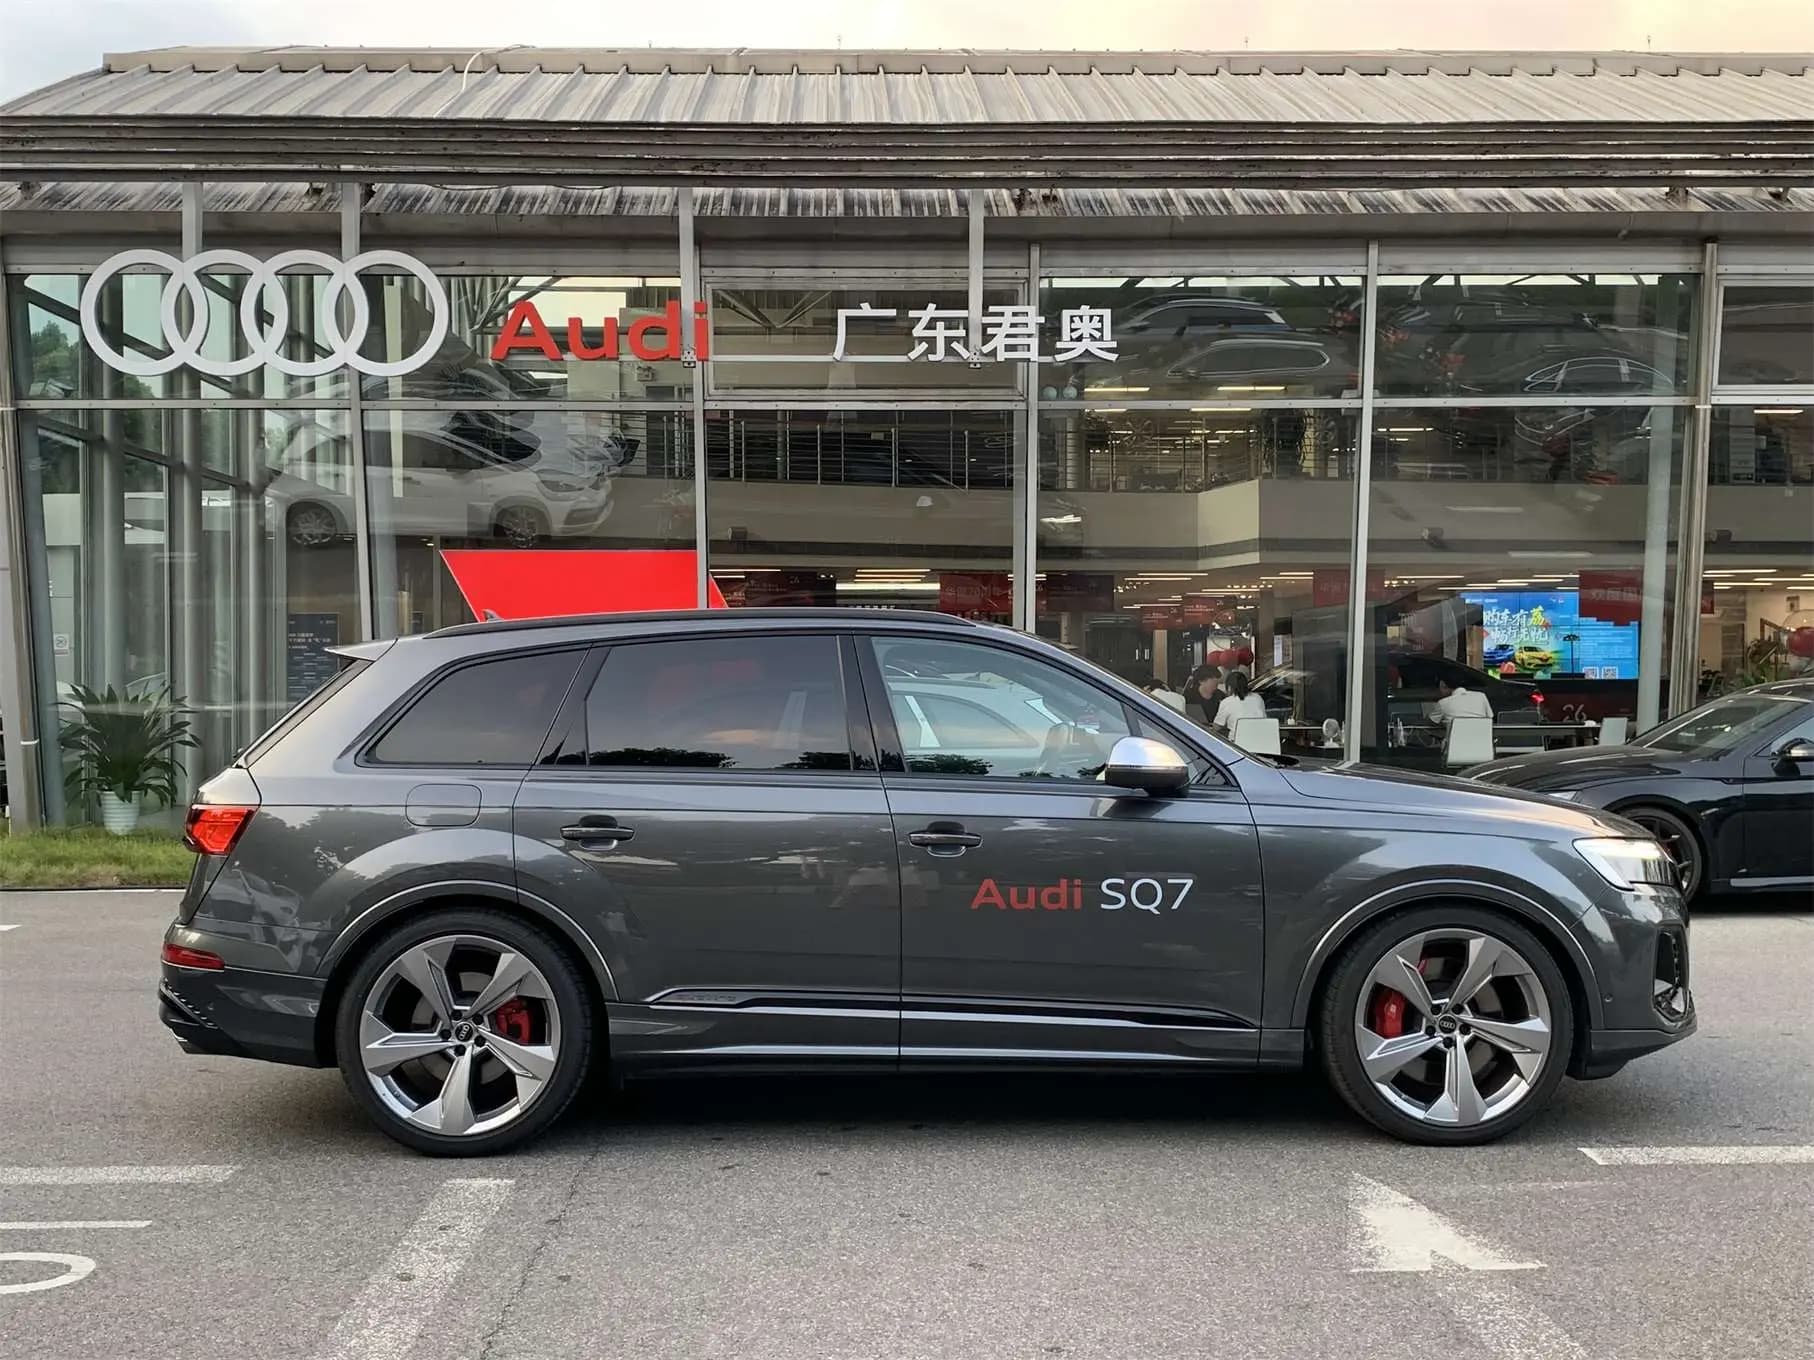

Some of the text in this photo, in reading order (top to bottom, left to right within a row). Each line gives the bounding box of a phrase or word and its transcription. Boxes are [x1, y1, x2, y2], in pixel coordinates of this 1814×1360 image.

[491, 300, 710, 361] Audi
[832, 303, 1119, 363] 广东君奥
[972, 878, 1195, 915] Audi SQ7
